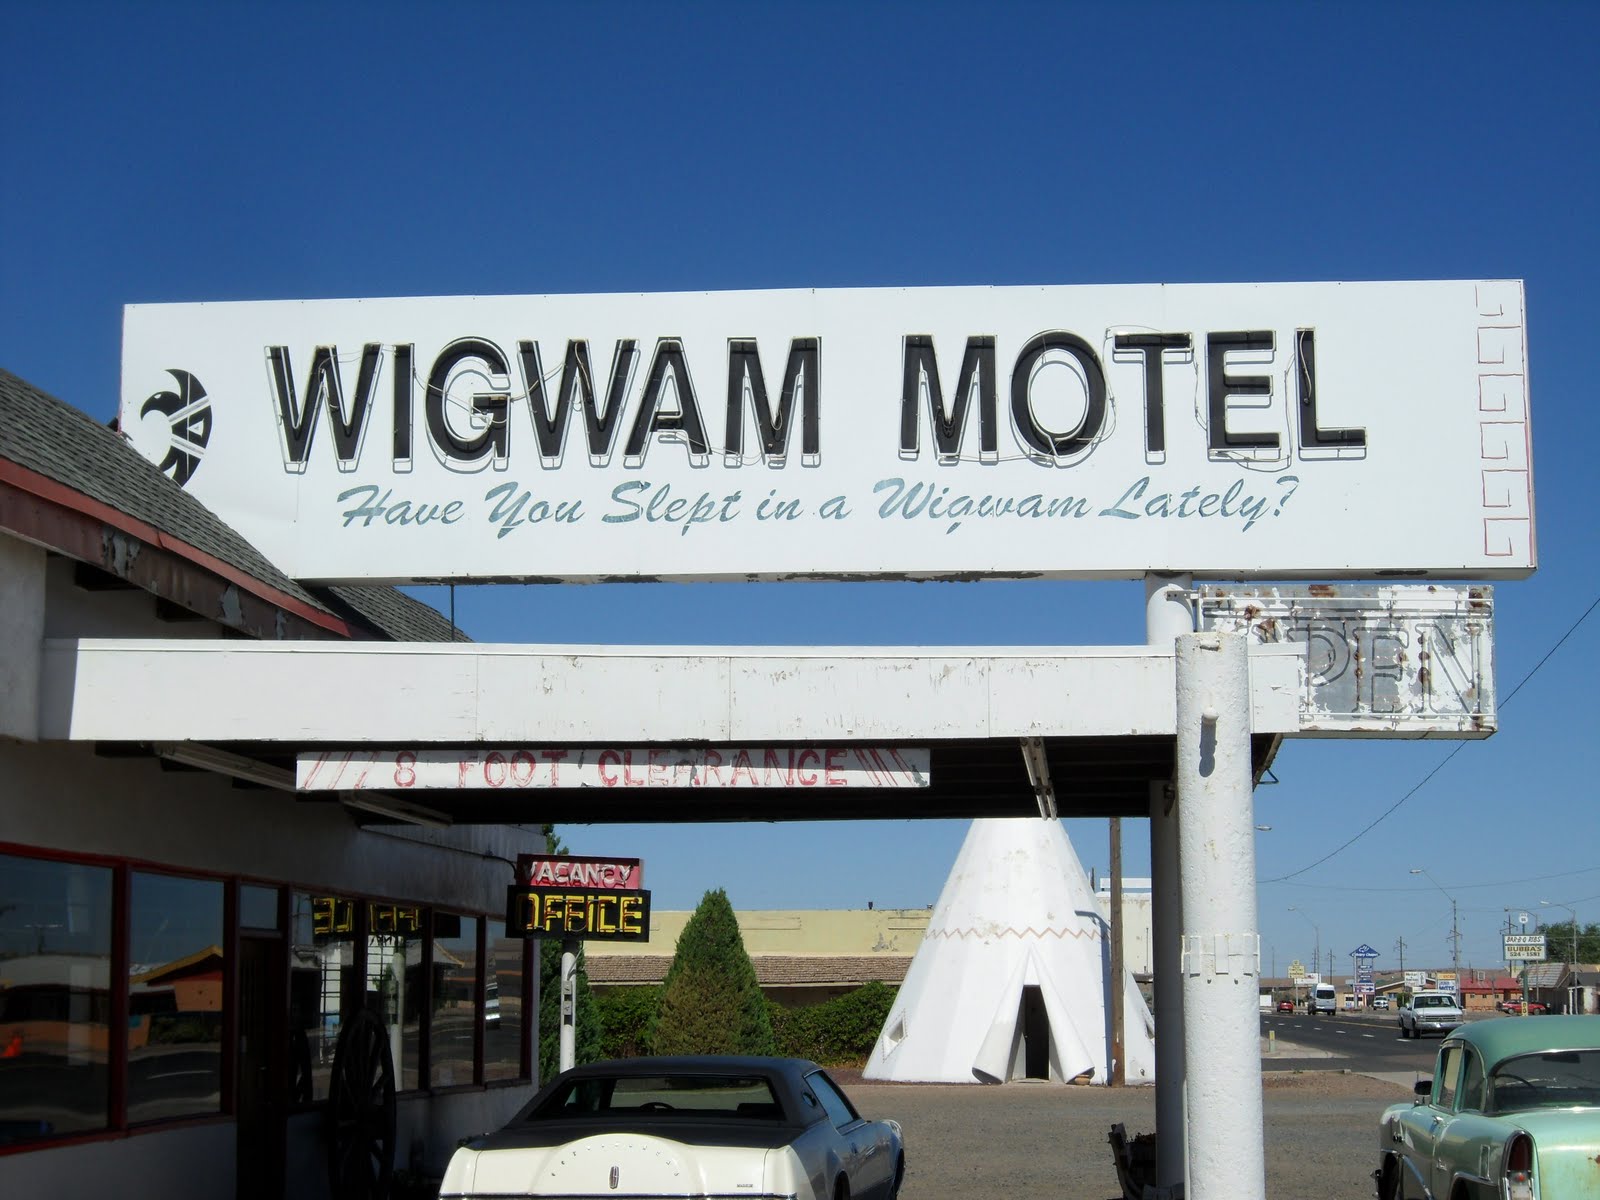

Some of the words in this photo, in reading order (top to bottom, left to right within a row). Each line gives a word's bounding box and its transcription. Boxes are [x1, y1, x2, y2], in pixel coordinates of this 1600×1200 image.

[263, 335, 824, 474] WIGWAM
[898, 326, 1368, 468] MOTEL
[337, 484, 465, 528] Have
[484, 481, 586, 540] You
[602, 480, 742, 537] Slept
[756, 488, 804, 521] in
[818, 495, 852, 520] a
[872, 477, 1093, 535] Wigwam
[1097, 475, 1300, 533] Lately?
[1250, 621, 1484, 719] PEN
[394, 750, 417, 788] 8
[458, 749, 569, 788] FOOT
[597, 748, 849, 788] CLEARANCE
[521, 860, 633, 887] VACANCY
[515, 893, 643, 934] OFFICE
